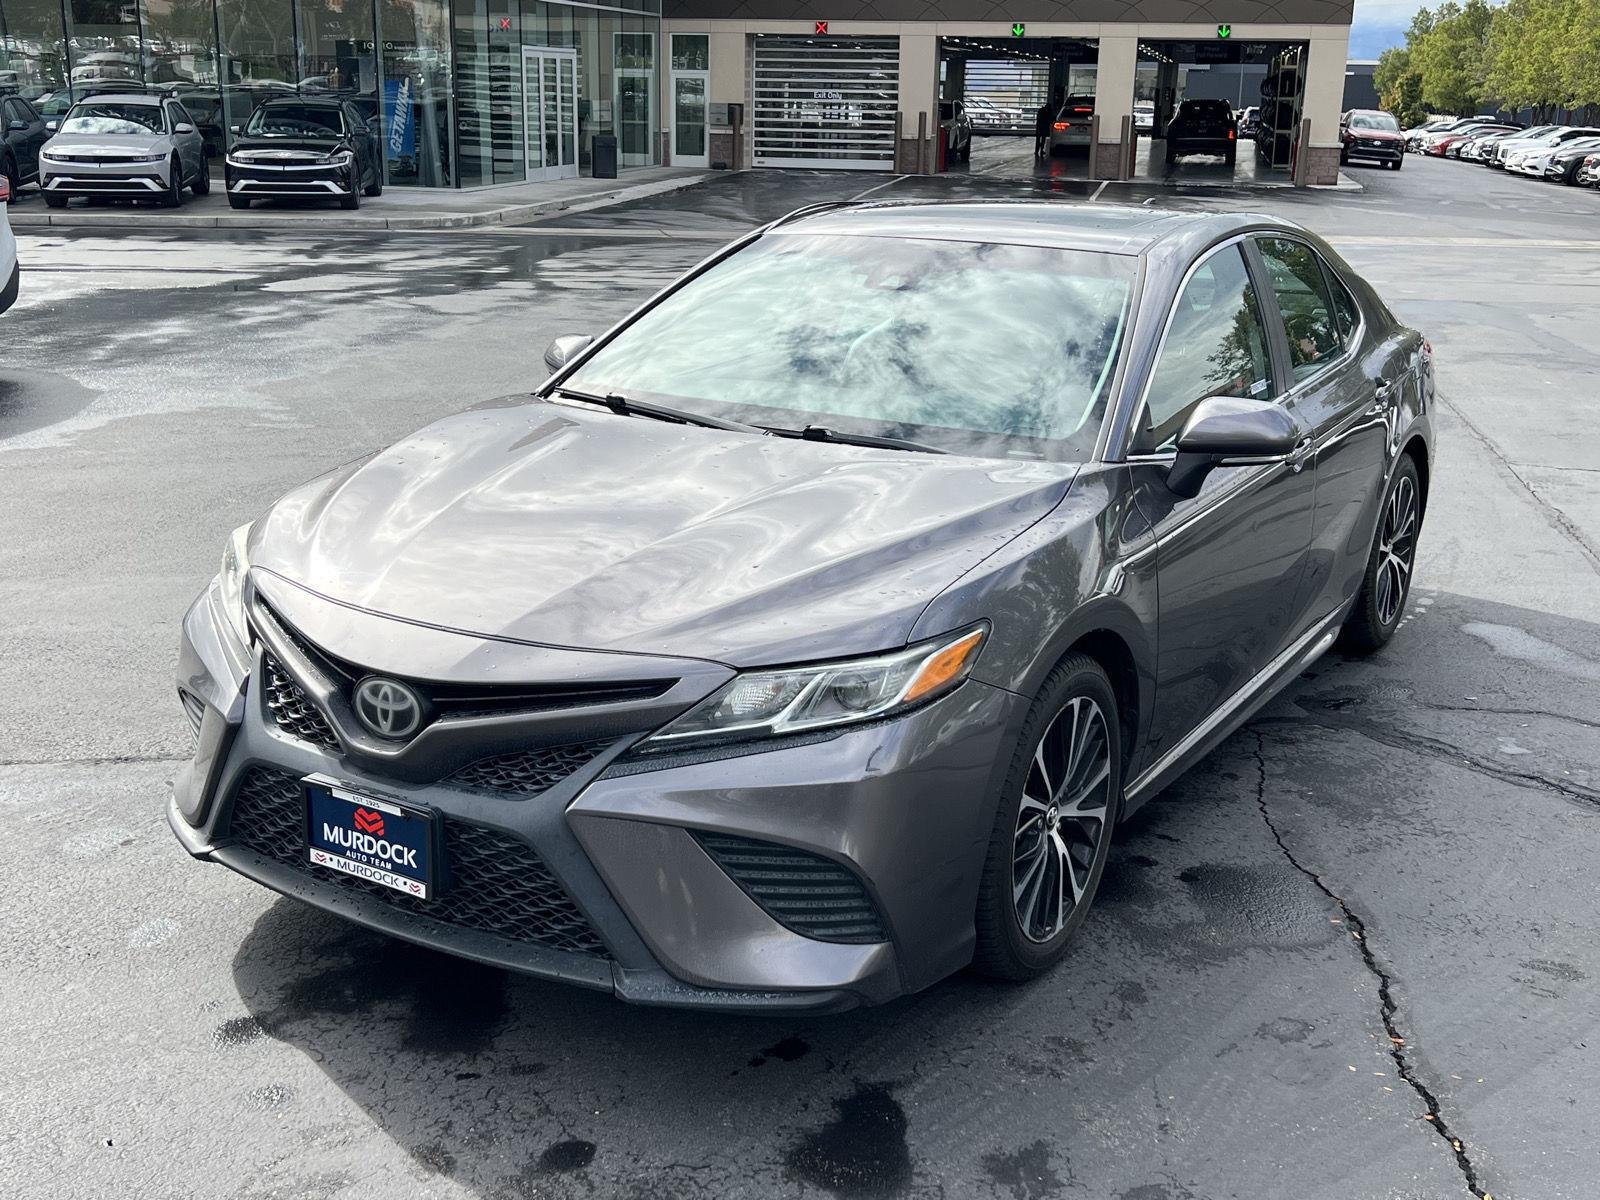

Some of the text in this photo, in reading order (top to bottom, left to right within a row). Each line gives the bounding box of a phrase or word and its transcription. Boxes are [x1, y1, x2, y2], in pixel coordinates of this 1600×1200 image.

[814, 91, 842, 100] Exit Only
[323, 822, 418, 869] MURDOCK
[345, 850, 392, 870] AUTO TEAM
[336, 858, 400, 888] MURDOCK
